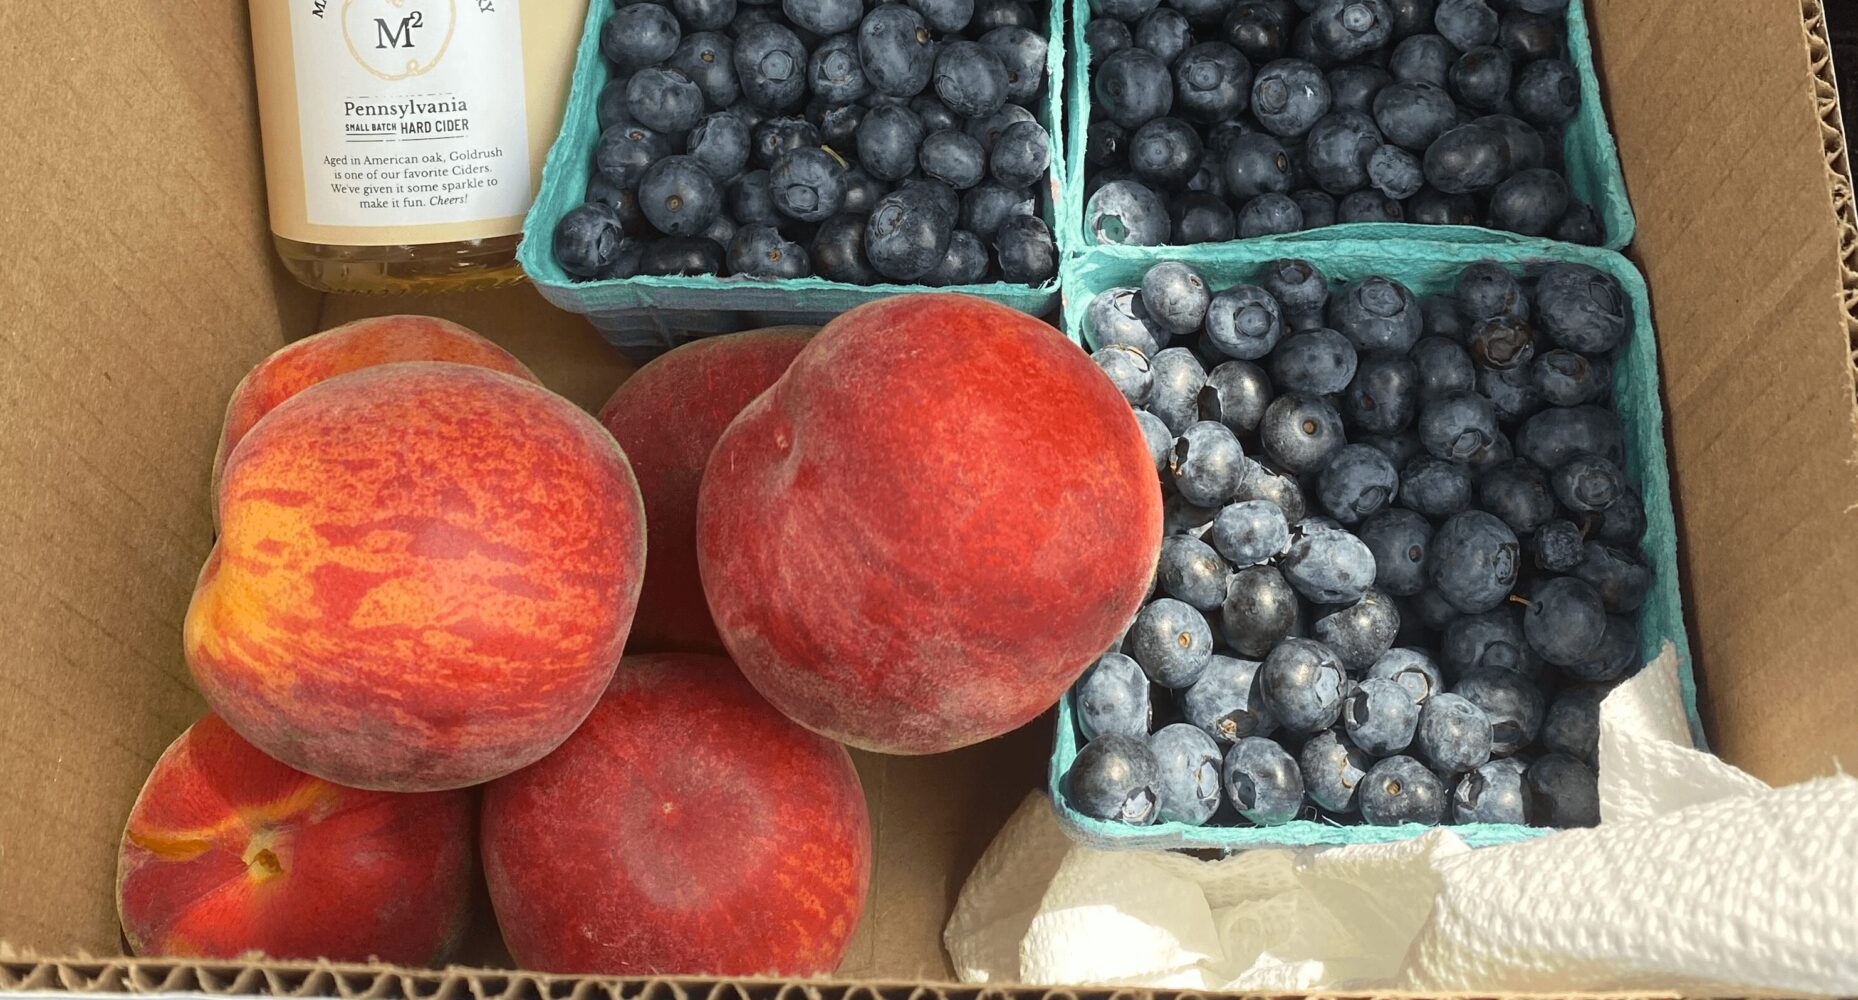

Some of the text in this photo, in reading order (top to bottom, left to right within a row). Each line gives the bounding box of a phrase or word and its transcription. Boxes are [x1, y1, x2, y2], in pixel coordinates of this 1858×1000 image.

[344, 97, 468, 119] Pennsylvania
[345, 118, 469, 135] SMALL BATCH HARD CIDER
[323, 147, 503, 167] Aged in American oak, Goldrush
[334, 164, 493, 180] is one of our favorite Ciders.
[331, 178, 498, 197] We've given it some sparkle to
[359, 194, 468, 209] make it fun. Cheers!
